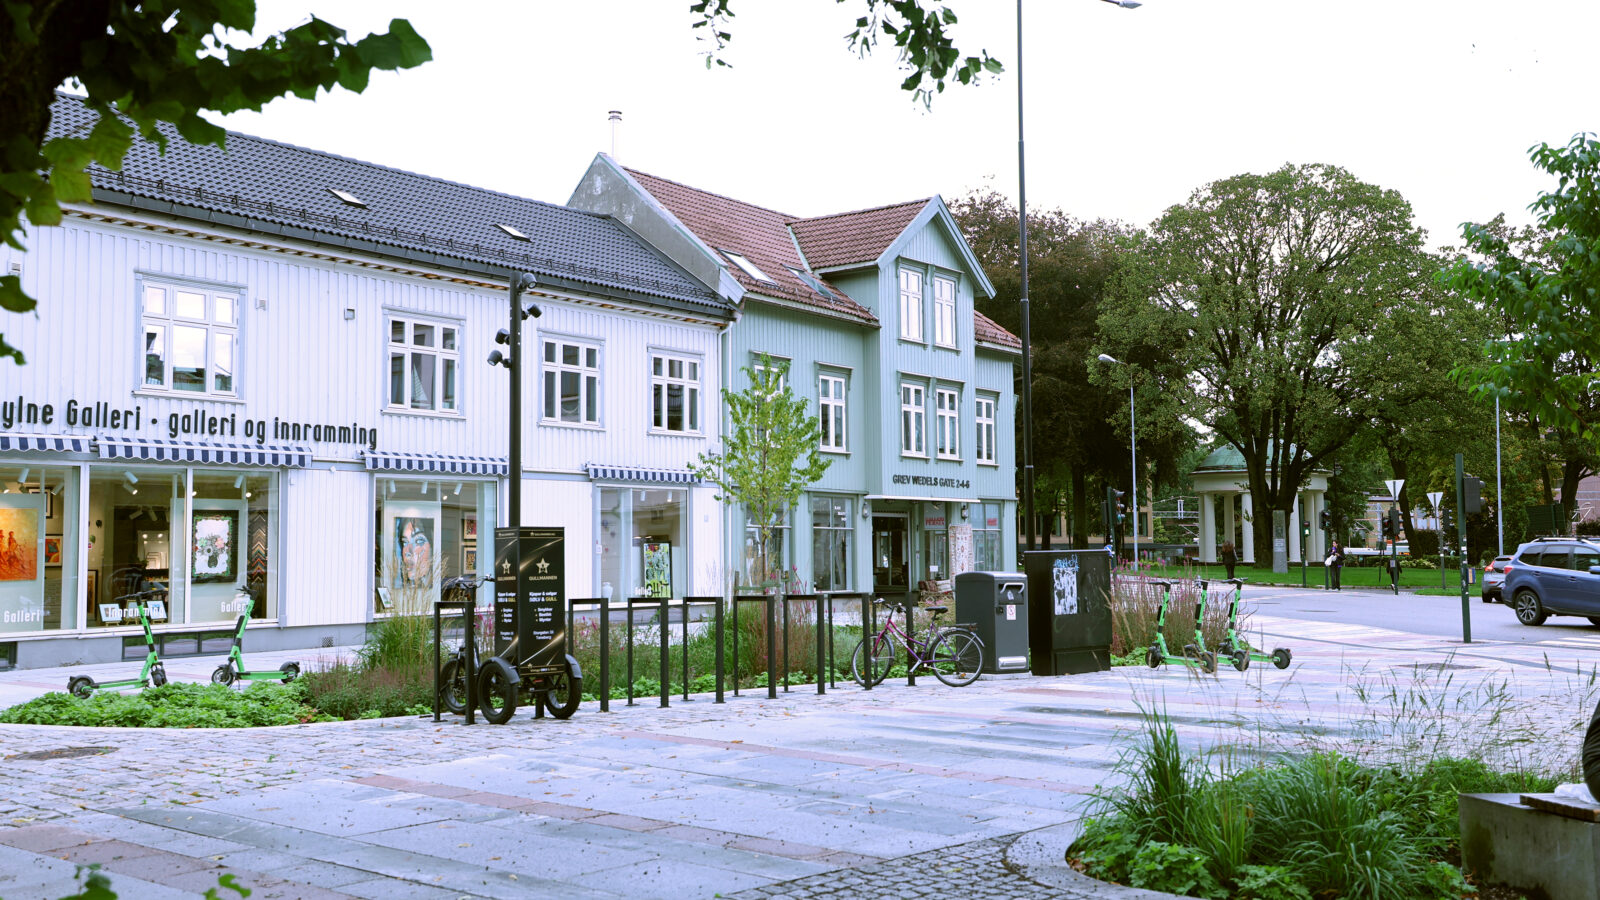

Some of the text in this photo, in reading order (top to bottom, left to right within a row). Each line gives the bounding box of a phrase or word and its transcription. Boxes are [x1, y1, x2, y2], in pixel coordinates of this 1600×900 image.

[66, 399, 141, 431] Galleri
[168, 409, 236, 438] galleri
[245, 419, 266, 444] og
[274, 416, 377, 450] innramming
[892, 474, 911, 485] GREV
[912, 475, 938, 487] WEDELS
[939, 478, 956, 488] GATE
[220, 601, 249, 613] Galler
[3, 610, 41, 623] Galleri
